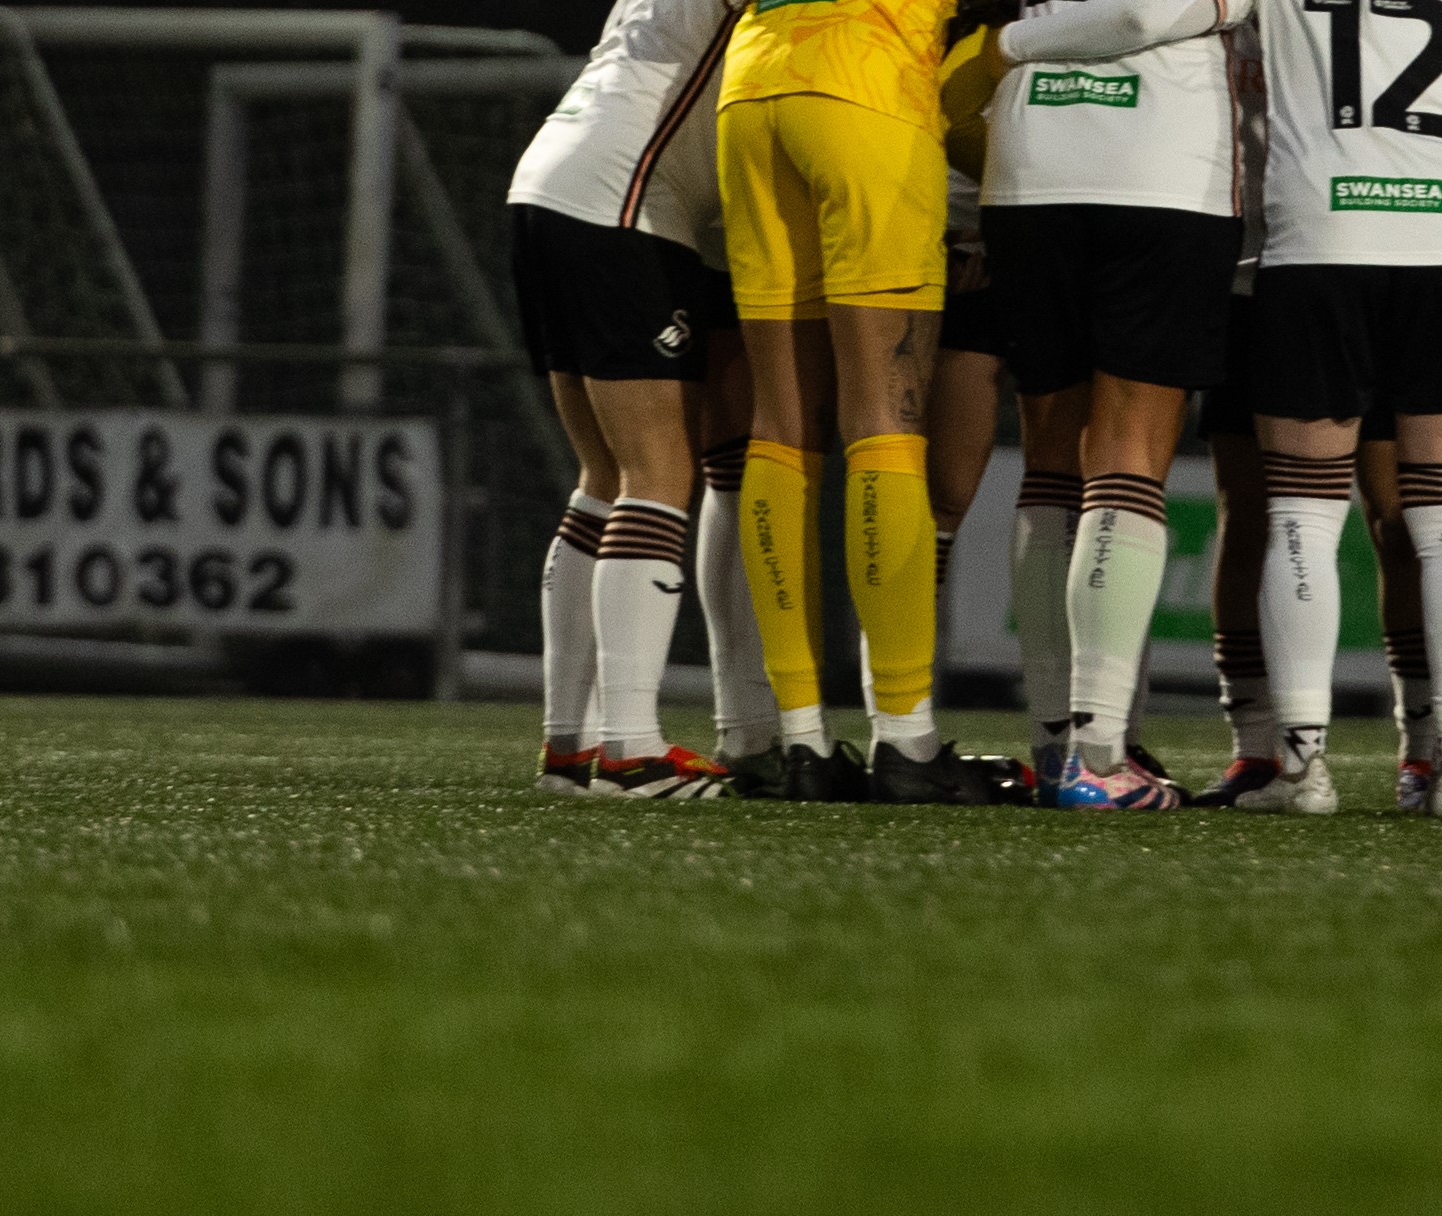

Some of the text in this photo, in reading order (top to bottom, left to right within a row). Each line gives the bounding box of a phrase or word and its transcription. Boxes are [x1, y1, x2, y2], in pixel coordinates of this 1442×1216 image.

[1035, 76, 1135, 96] SWANSEA
[133, 426, 177, 524] &
[213, 428, 413, 530] SONS
